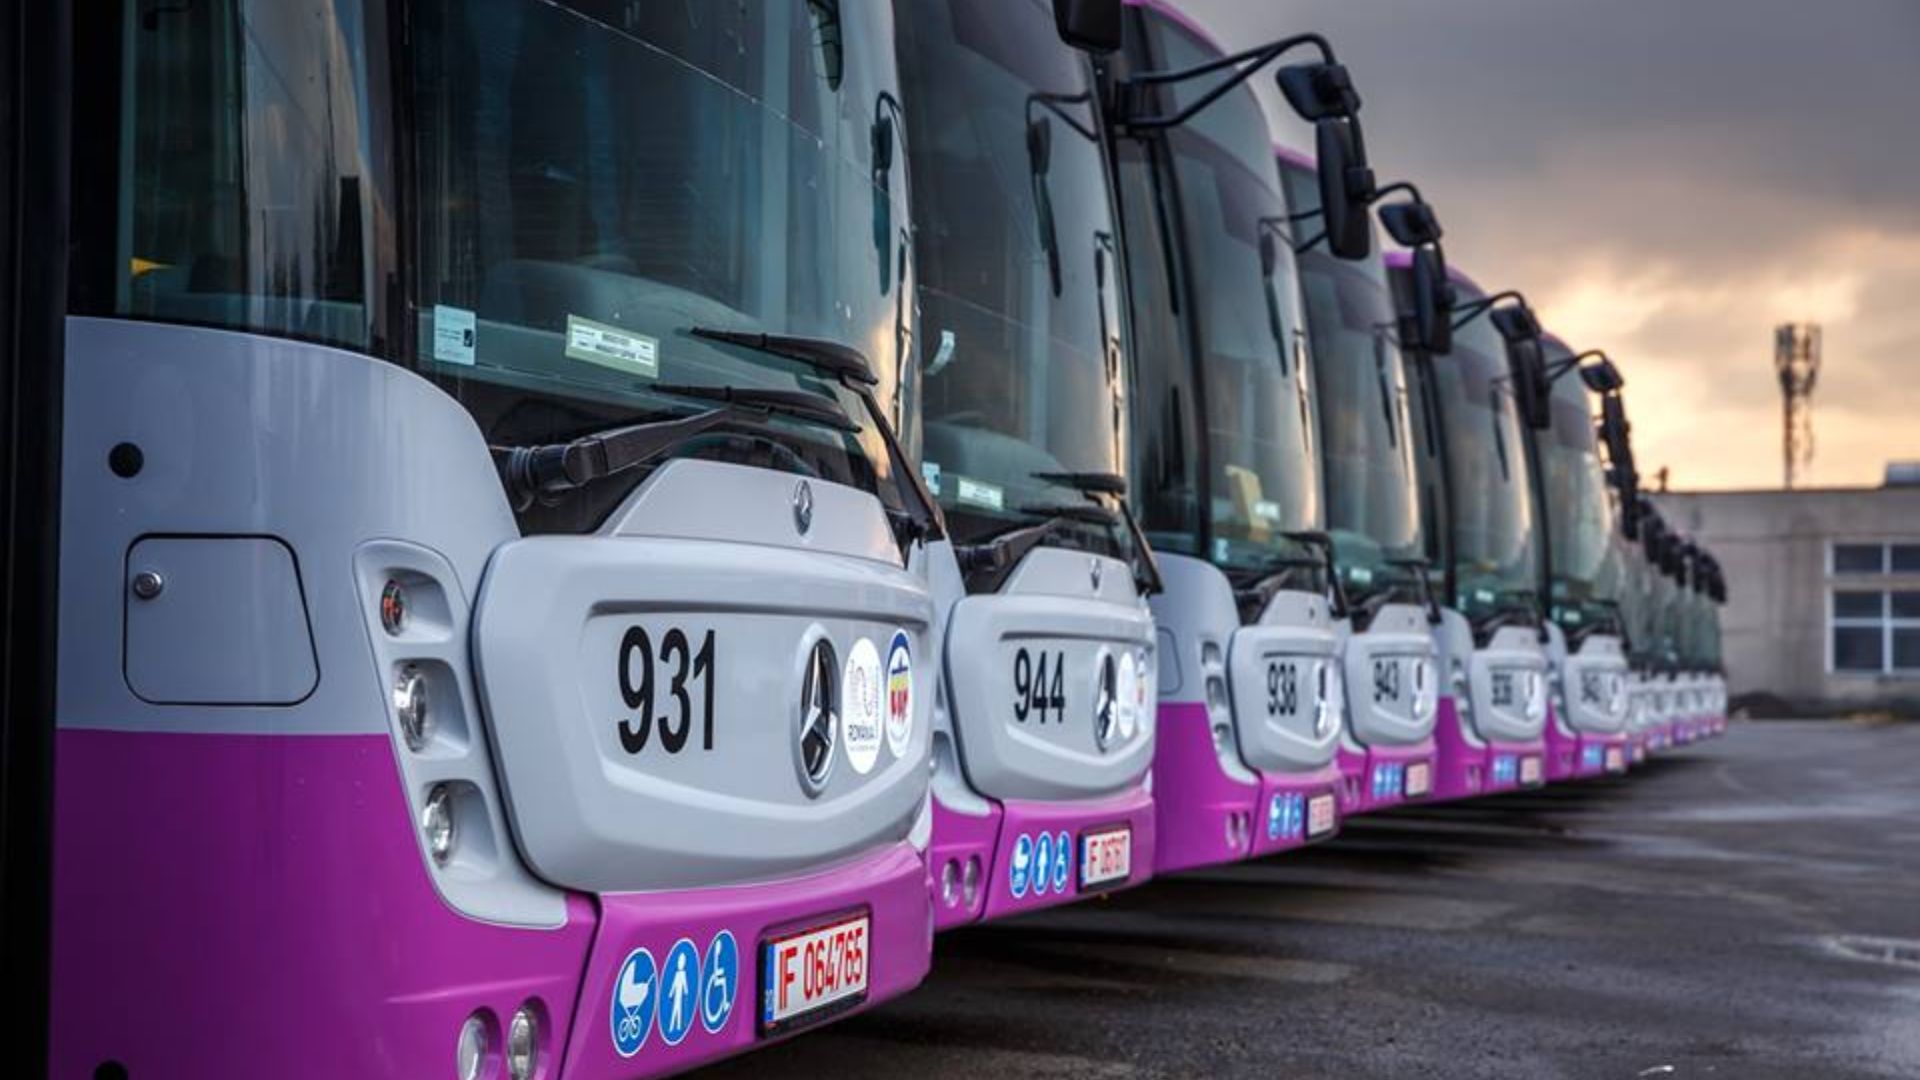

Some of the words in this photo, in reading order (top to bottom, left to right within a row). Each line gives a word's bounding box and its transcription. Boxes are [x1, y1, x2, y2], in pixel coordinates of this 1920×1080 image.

[617, 625, 715, 754] 931
[1014, 648, 1066, 724] 944
[1267, 661, 1297, 716] 938
[1373, 660, 1399, 702] 943
[779, 946, 798, 1011] IF
[804, 927, 863, 1000] 064765
